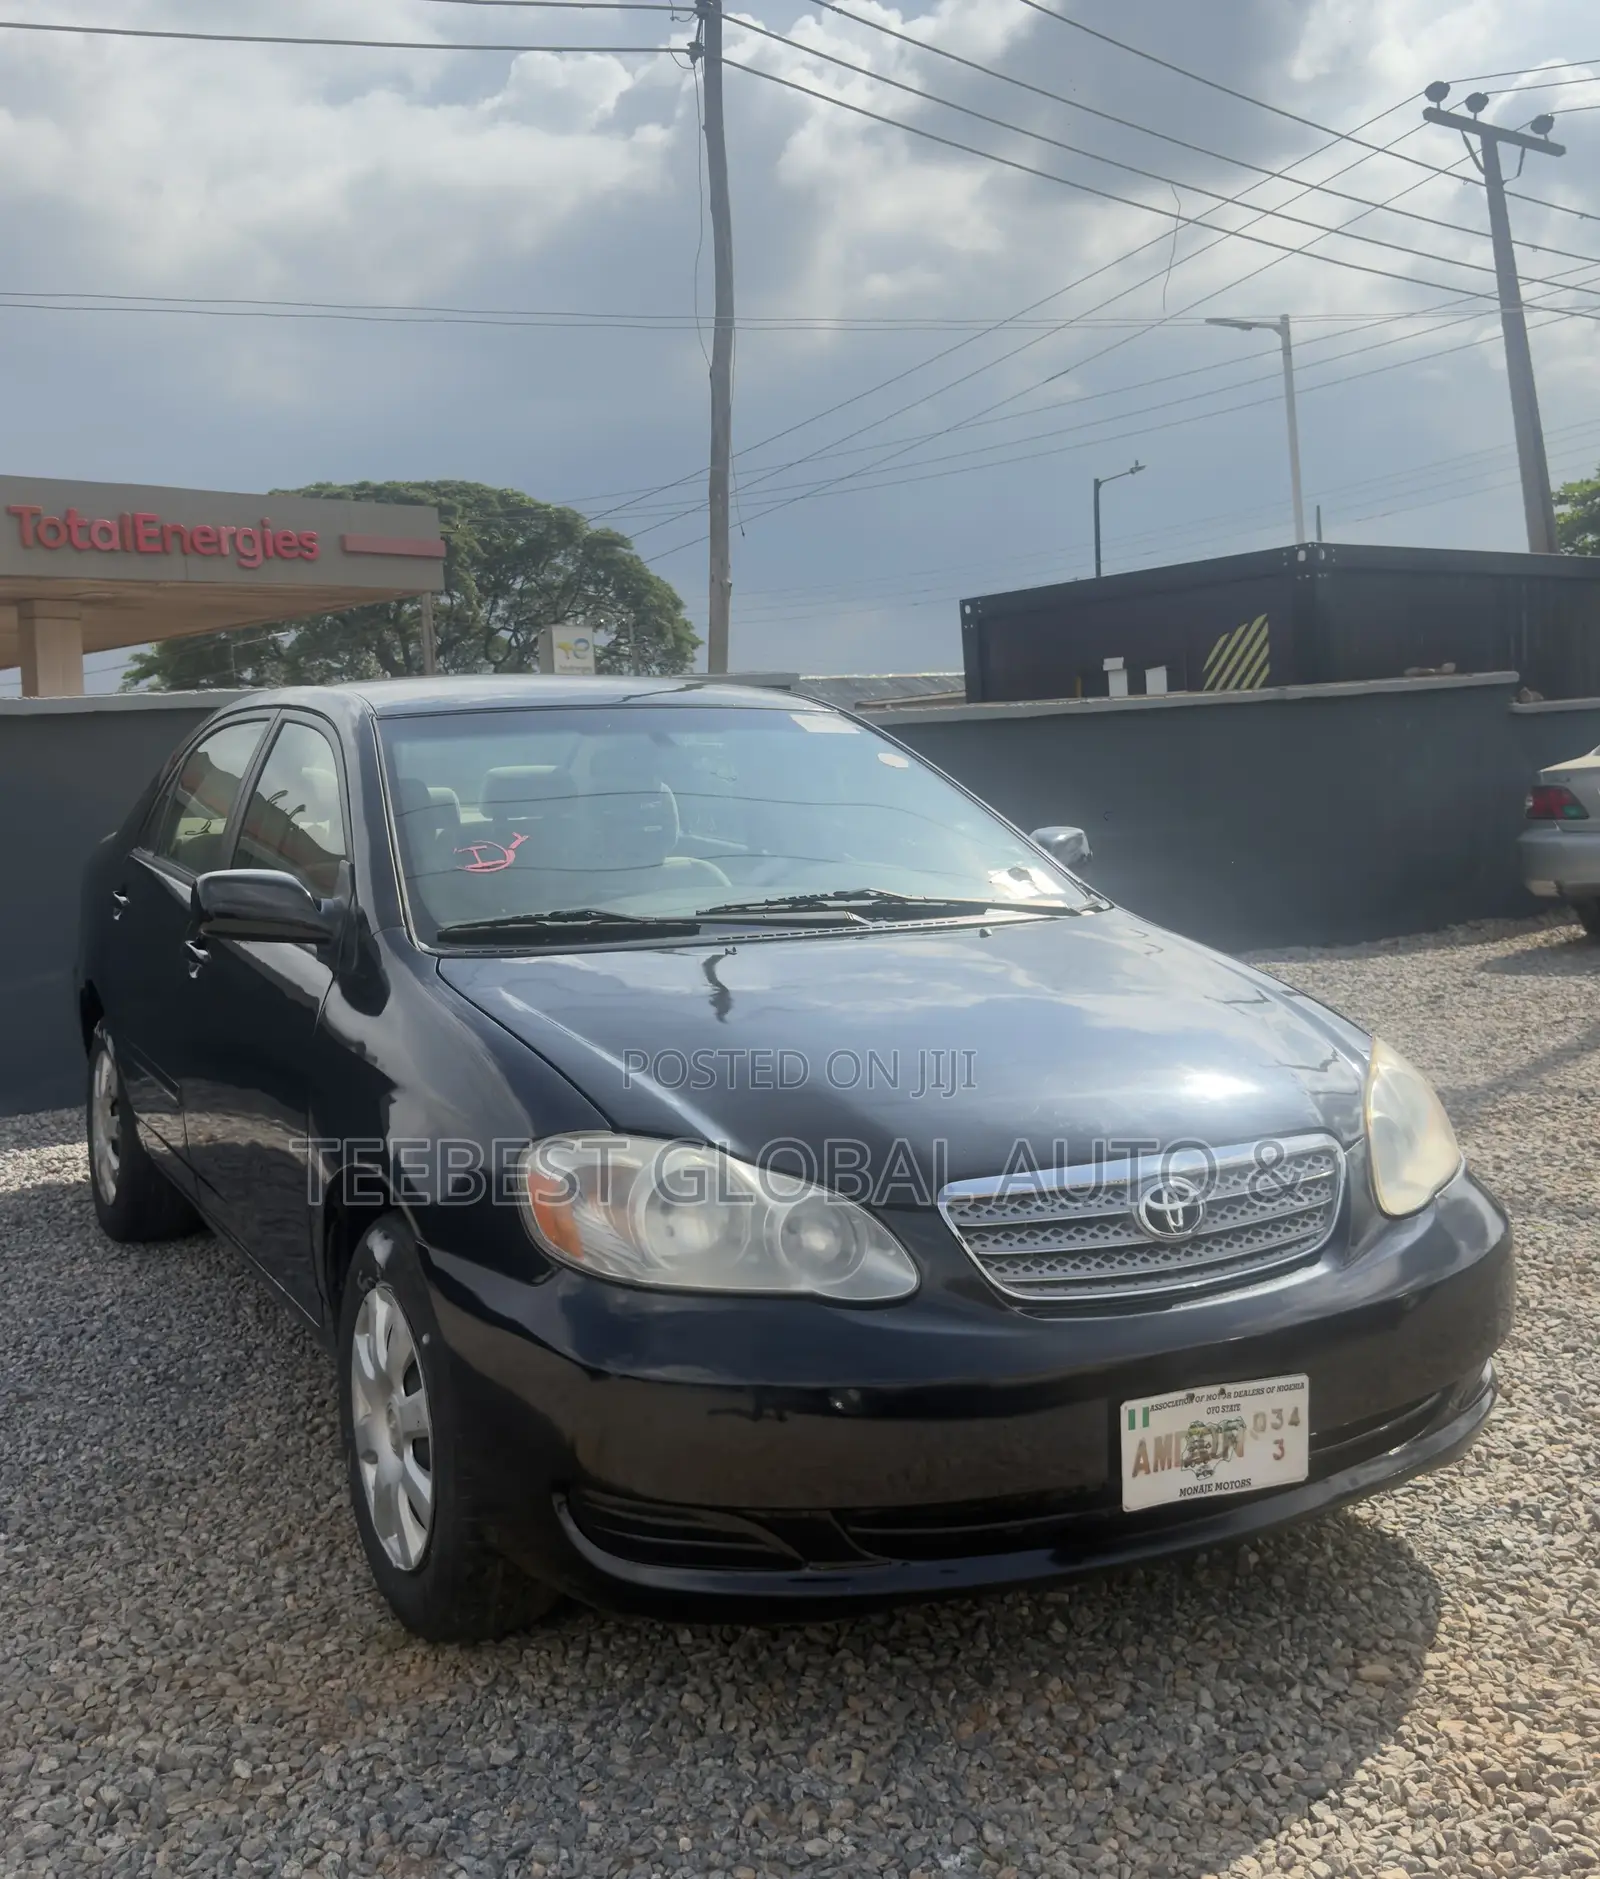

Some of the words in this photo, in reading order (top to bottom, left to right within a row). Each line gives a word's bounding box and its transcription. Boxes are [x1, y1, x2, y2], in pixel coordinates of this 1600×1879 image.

[7, 504, 320, 569] TotalEnergies
[1149, 1394, 1195, 1412] ASSOCIATION
[1195, 1394, 1206, 1404] OF
[1233, 1387, 1265, 1399] DEALERS
[1266, 1385, 1276, 1394] OF
[1276, 1382, 1305, 1393] NIGERIA
[1206, 1405, 1221, 1415] OYO
[1221, 1403, 1241, 1414] STATE
[1179, 1483, 1214, 1497] MONAJE
[1214, 1478, 1252, 1492] MOTORS
